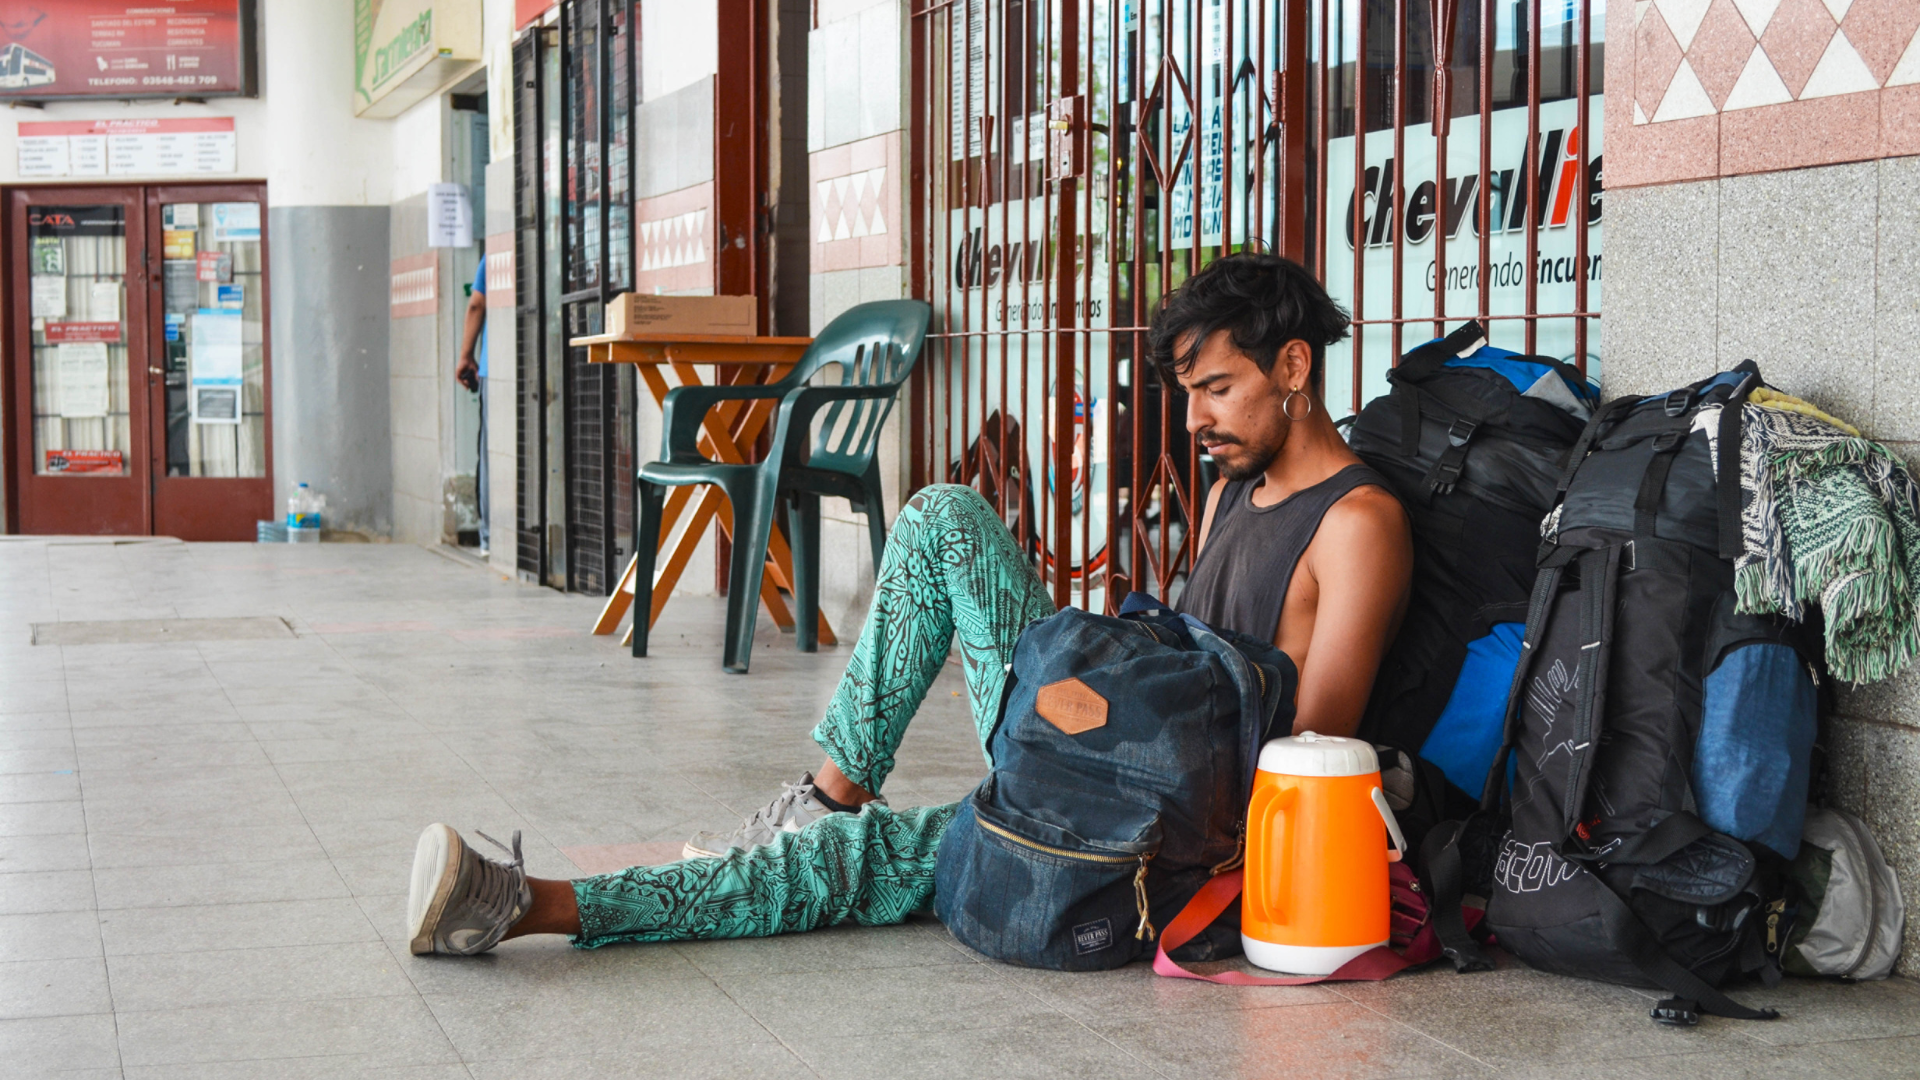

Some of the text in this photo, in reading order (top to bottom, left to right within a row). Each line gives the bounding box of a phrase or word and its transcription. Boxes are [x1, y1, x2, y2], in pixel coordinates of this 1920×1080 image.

[199, 75, 218, 85] 709
[29, 213, 76, 226] CATA
[1172, 210, 1223, 239] MOON
[1425, 252, 1524, 292] Gnerndo
[995, 296, 1044, 322] Gnerndo
[1095, 928, 1109, 939] PASS
